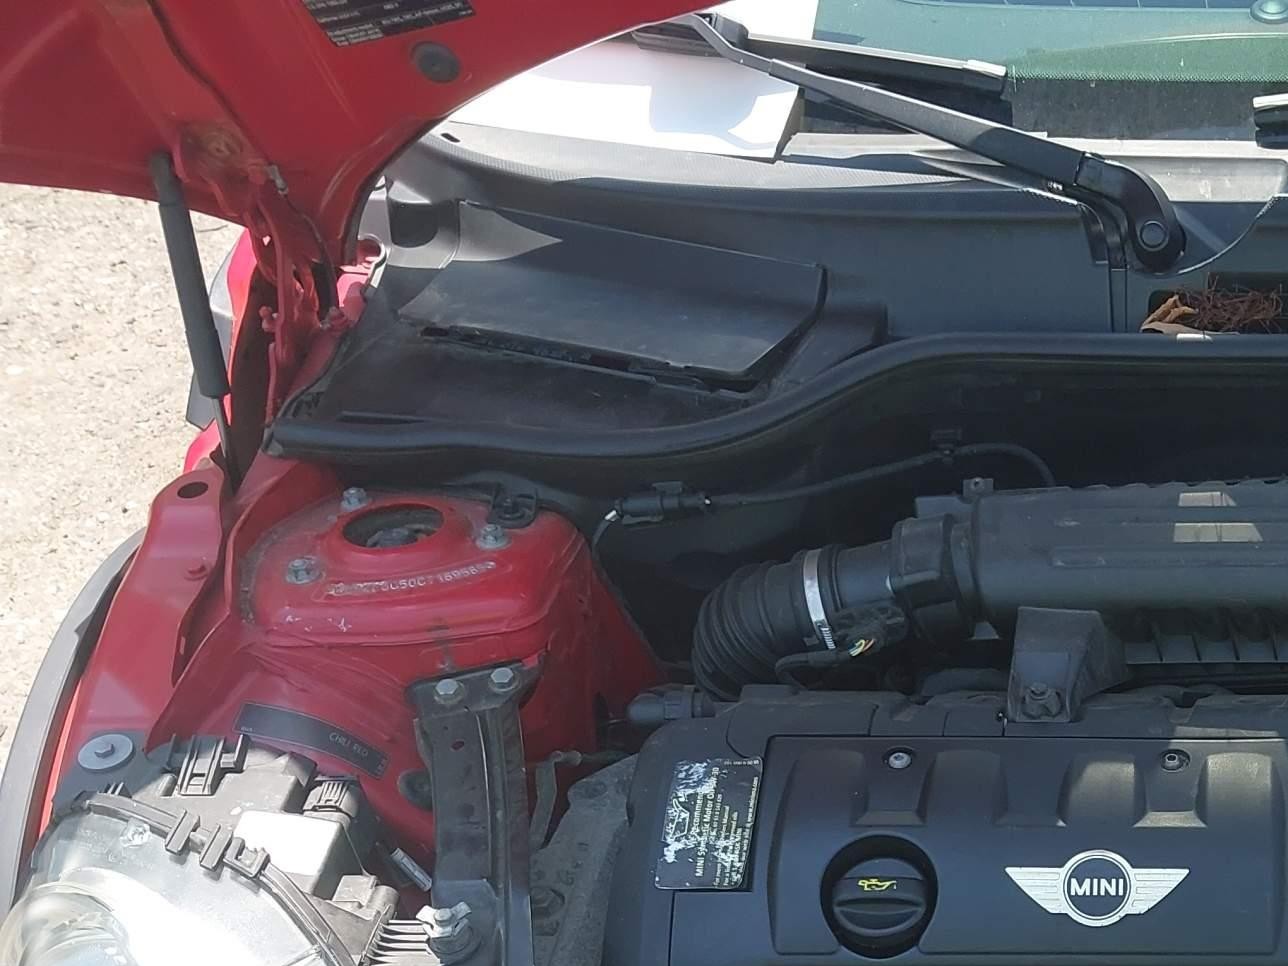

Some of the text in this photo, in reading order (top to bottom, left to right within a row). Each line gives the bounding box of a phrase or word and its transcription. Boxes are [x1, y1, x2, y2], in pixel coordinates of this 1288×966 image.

[696, 857, 705, 876] MINI
[705, 800, 714, 822] Motor
[1070, 878, 1124, 896] MINI
